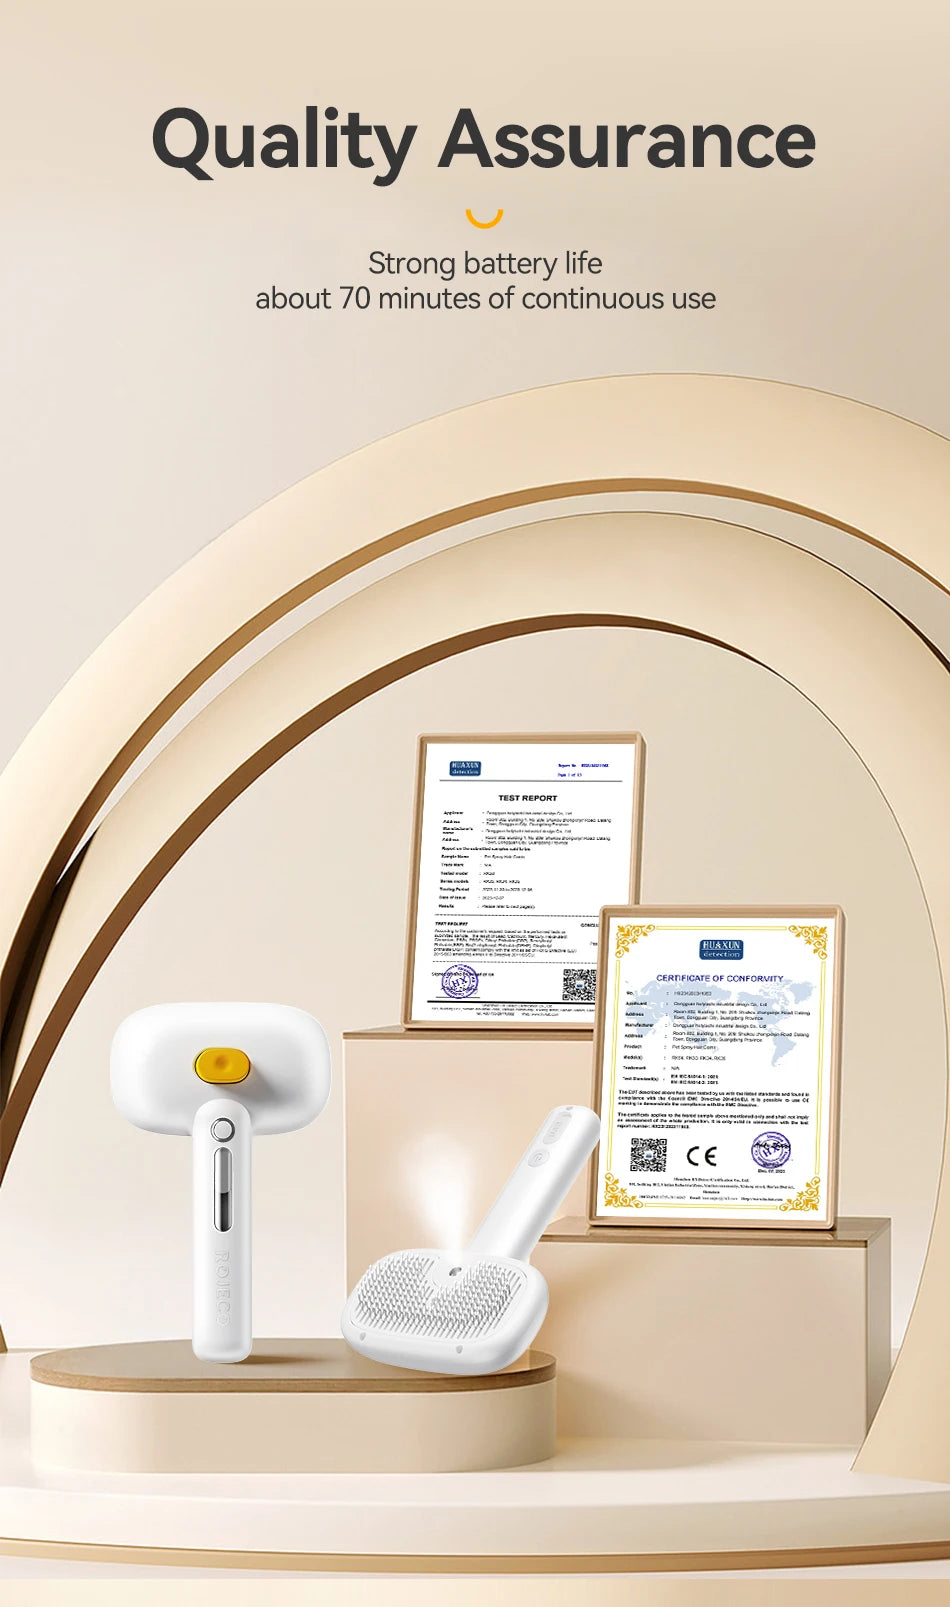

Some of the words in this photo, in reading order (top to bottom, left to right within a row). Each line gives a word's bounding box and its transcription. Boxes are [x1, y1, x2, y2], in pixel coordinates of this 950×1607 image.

[703, 941, 740, 950] HUAXUN
[686, 1146, 717, 1166] CE
[215, 1250, 231, 1328] ROJECO
